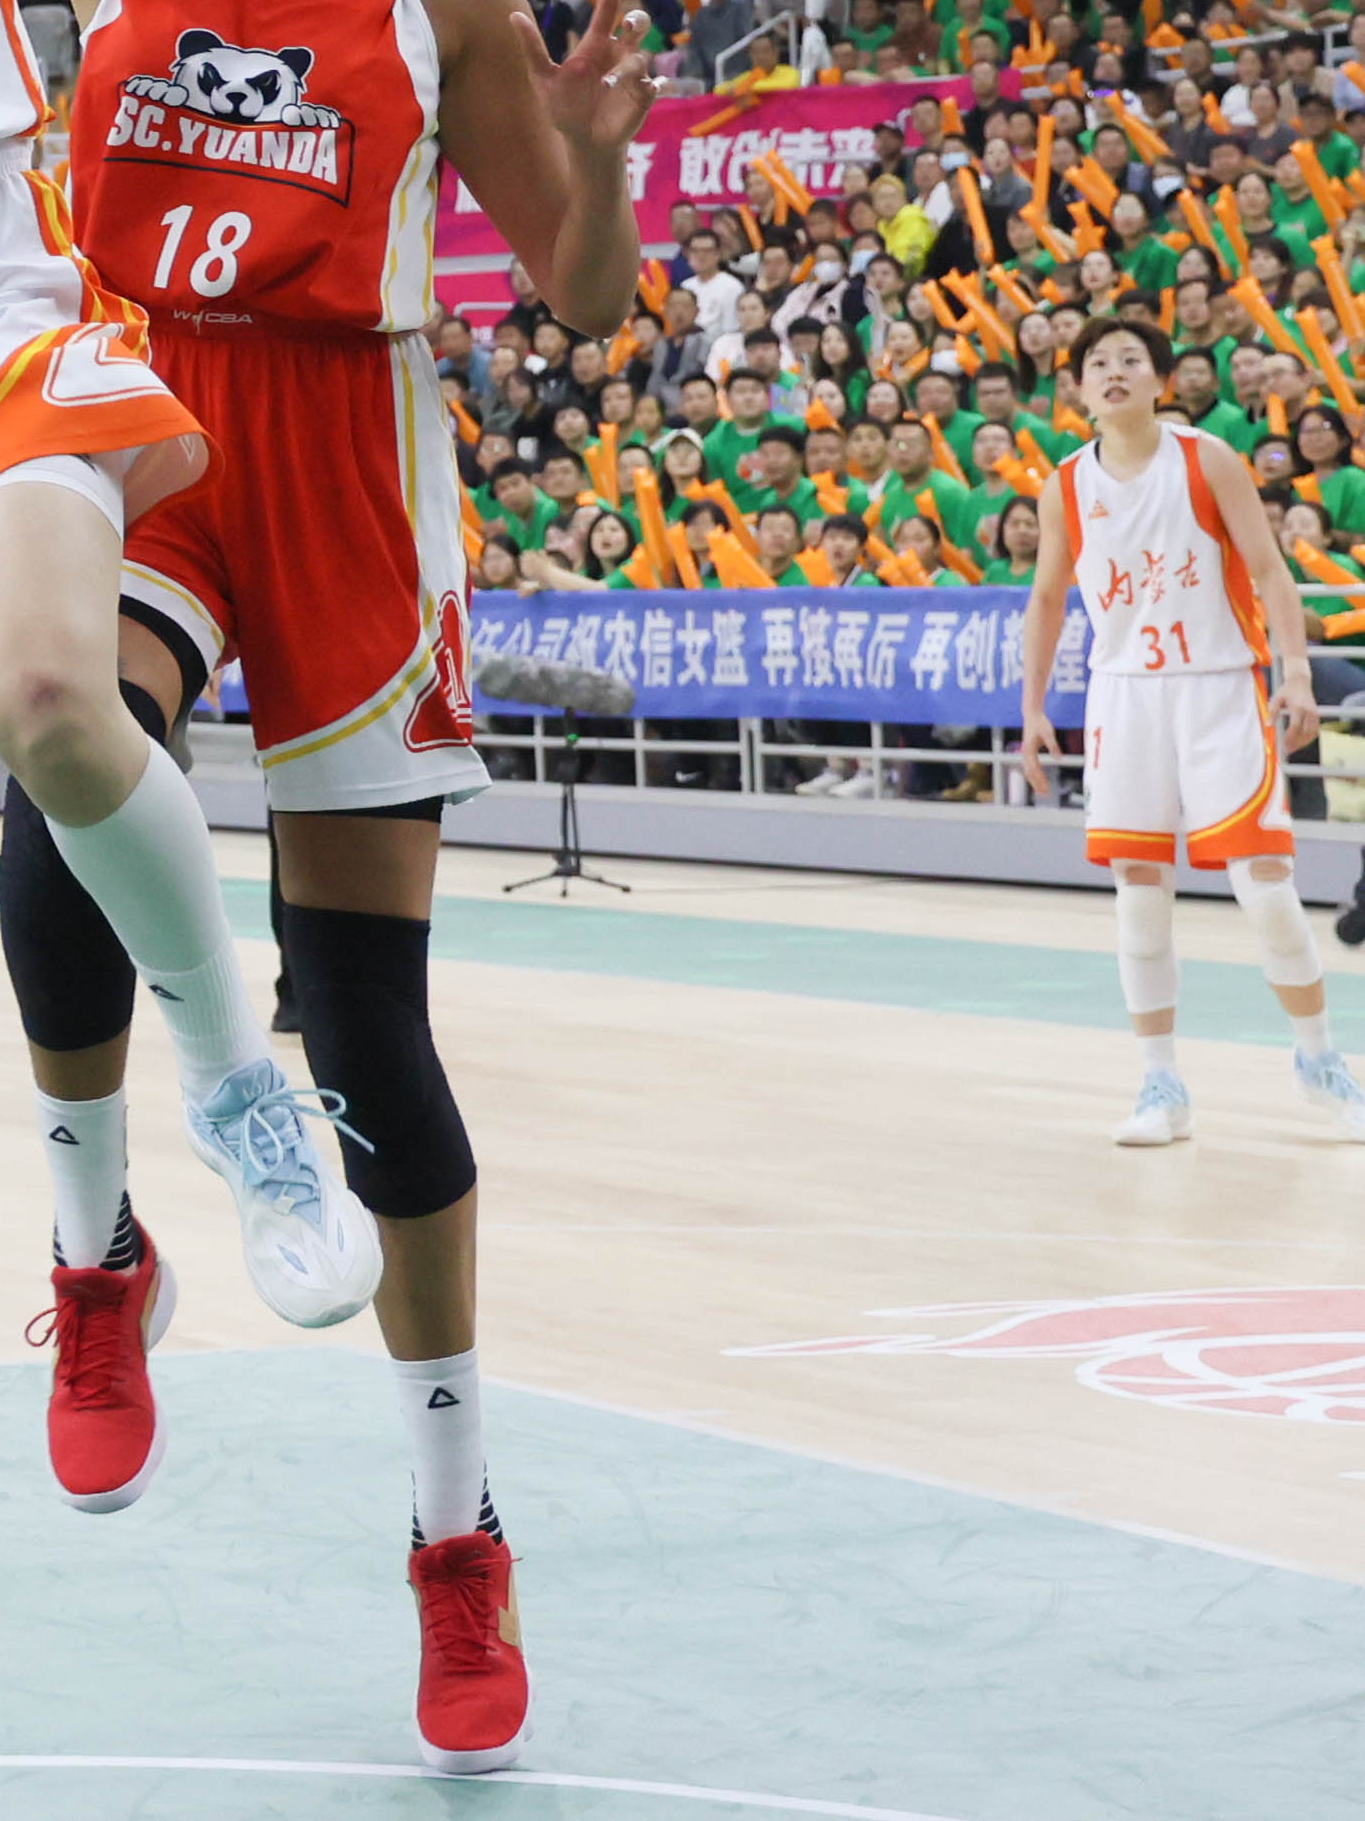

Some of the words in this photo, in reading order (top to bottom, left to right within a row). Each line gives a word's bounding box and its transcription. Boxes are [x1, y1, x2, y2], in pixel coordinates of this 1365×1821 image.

[106, 96, 339, 185] SC.YUANDA
[154, 204, 252, 298] 18
[174, 310, 253, 327] WCBA
[1098, 550, 1200, 612] 内蒙古
[1141, 621, 1192, 670] 31
